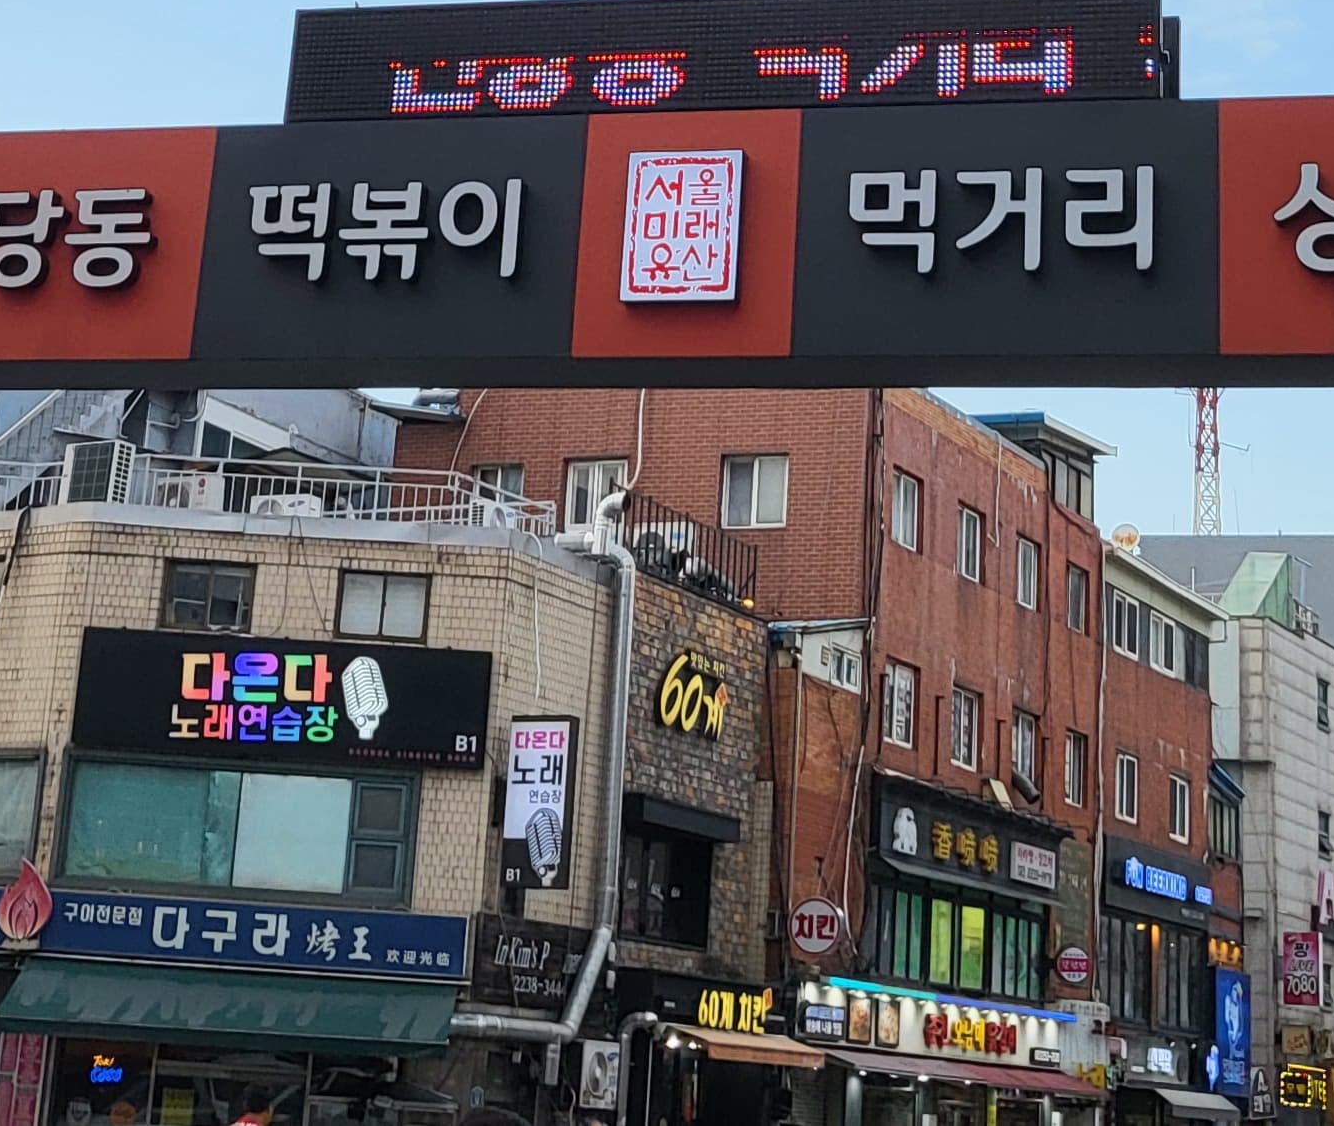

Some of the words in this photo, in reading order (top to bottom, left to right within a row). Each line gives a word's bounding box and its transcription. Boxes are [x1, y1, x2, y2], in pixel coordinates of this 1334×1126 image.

[645, 168, 723, 206] 서울
[248, 178, 524, 281] 떡볶이
[850, 166, 1160, 272] 먹거리
[643, 209, 720, 240] 미래
[641, 242, 719, 282] 유산
[181, 652, 333, 702] 다온다
[169, 704, 338, 742] 노래연습장
[455, 735, 477, 753] B1
[515, 731, 565, 750] 다온다
[512, 755, 563, 785] 노래
[529, 789, 562, 804] 연습장
[506, 868, 520, 882] B1
[64, 902, 142, 927] 구이전문점
[152, 906, 291, 956] 다구라
[795, 913, 835, 940] 치킨
[306, 920, 372, 962] 烤王
[386, 949, 450, 967] 欢迎光临
[514, 975, 565, 996] 2238-344
[1287, 975, 1316, 996] 7080
[698, 988, 734, 1030] 60계
[738, 991, 767, 1034] 치킨
